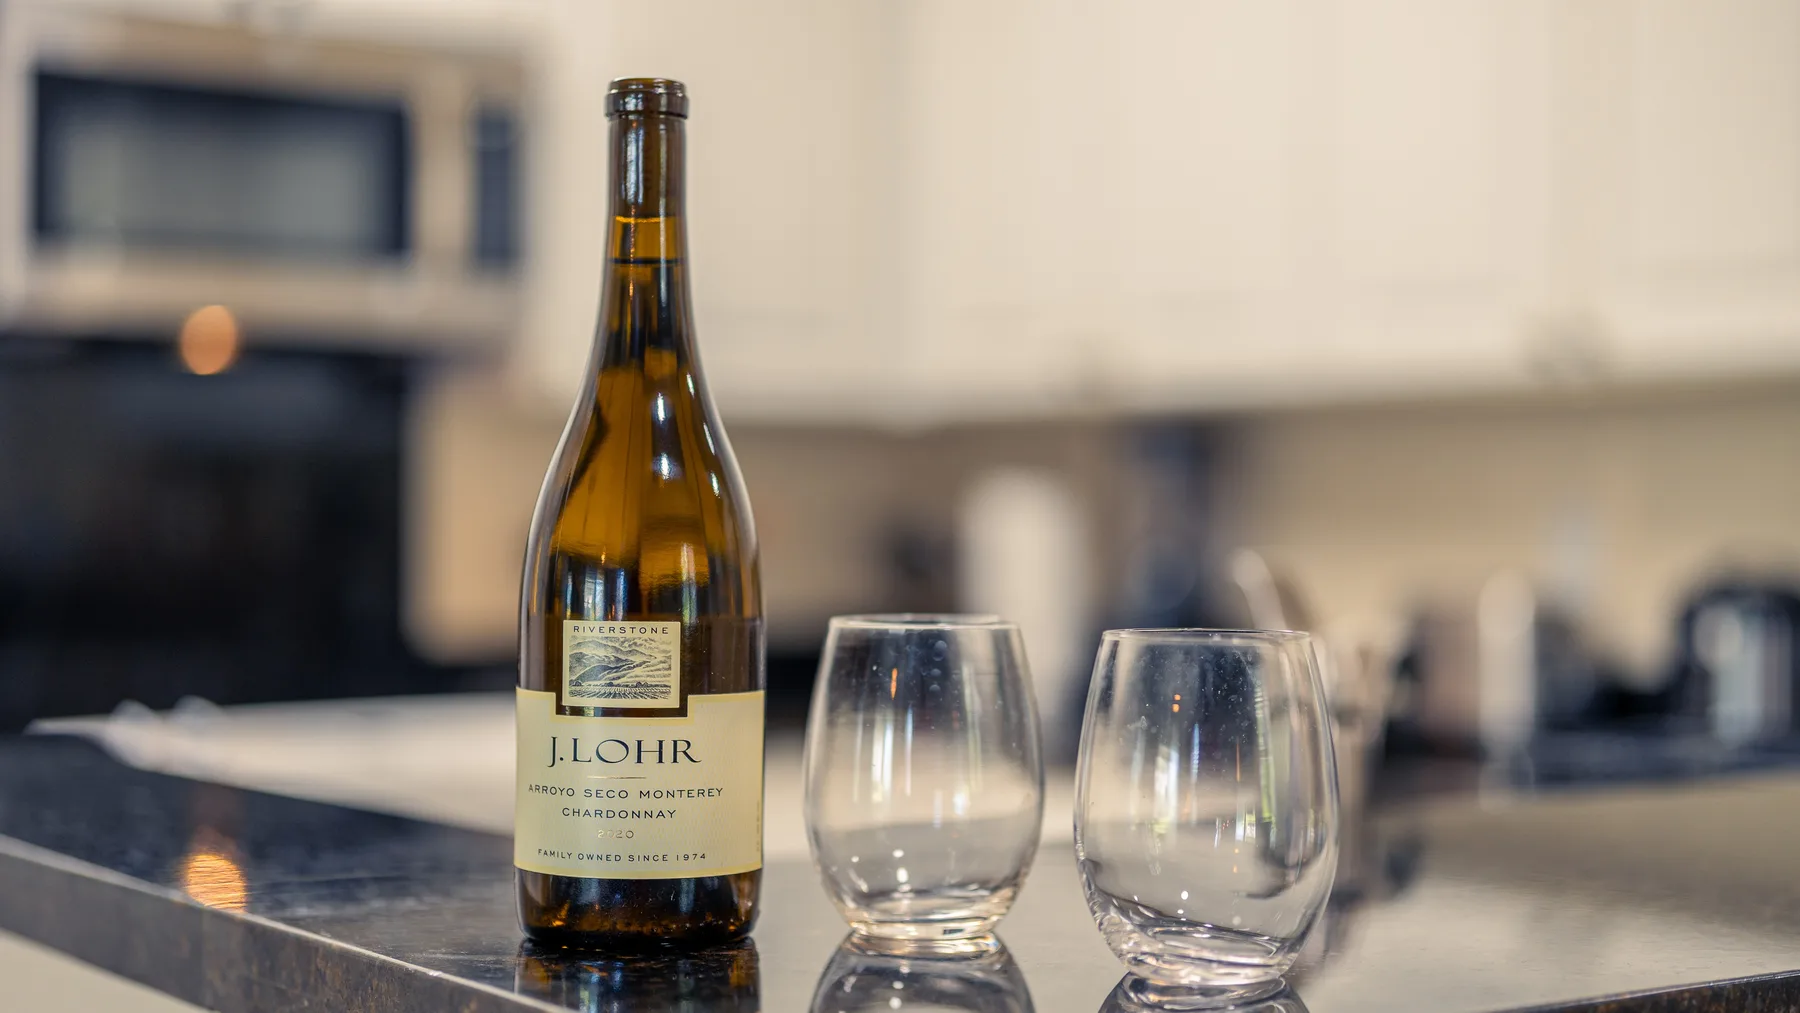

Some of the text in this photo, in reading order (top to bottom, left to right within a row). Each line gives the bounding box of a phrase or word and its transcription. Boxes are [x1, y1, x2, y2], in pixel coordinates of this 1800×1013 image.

[573, 625, 669, 635] RIVERSTONE
[528, 784, 724, 799] ARROYO SECO MONTEREY
[562, 807, 677, 819] CHARDONNAY
[597, 829, 635, 839] 2020
[537, 848, 706, 862] FAMILY OWNED SINCE 1974
